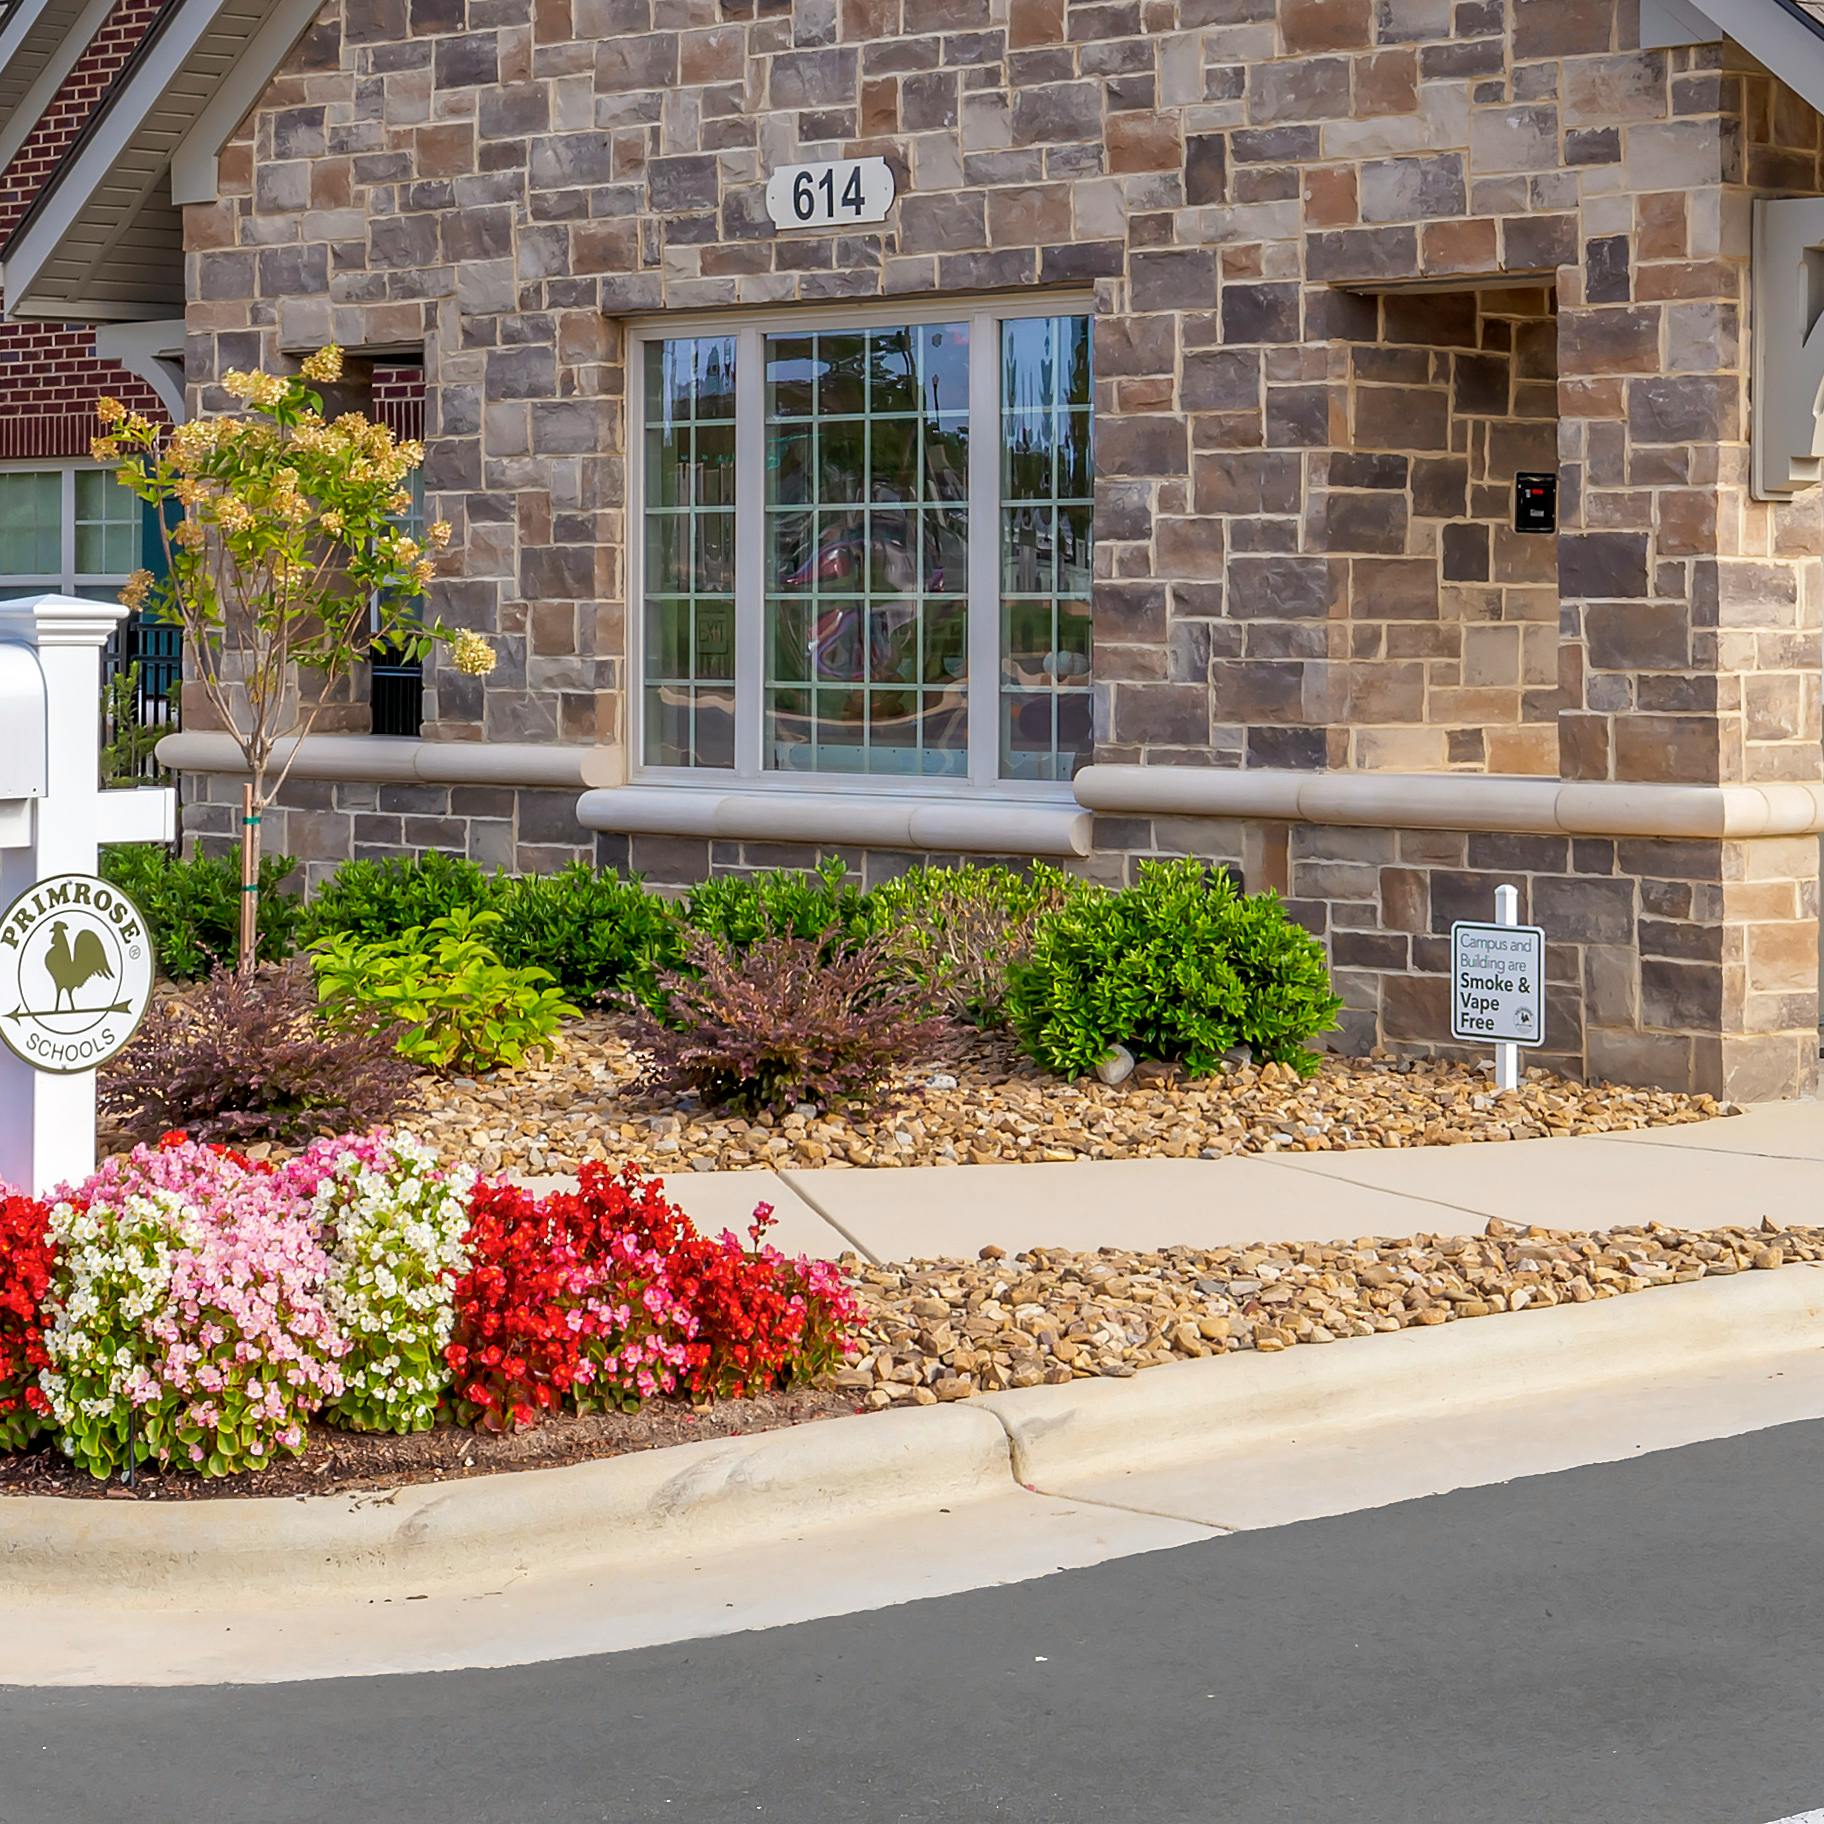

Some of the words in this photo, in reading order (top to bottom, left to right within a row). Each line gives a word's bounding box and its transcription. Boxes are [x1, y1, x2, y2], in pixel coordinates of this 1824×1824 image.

[793, 166, 866, 221] 614
[0, 882, 141, 950] PRIMROSE
[1460, 933, 1507, 953] Campus
[1511, 938, 1532, 953] and
[1460, 953, 1506, 974] Building
[1508, 960, 1526, 972] are
[1460, 972, 1514, 992] Smoke
[1518, 976, 1530, 994] &
[1460, 992, 1500, 1014] Vape
[1460, 1012, 1495, 1031] Free
[26, 1028, 116, 1062] SCHOOLS
